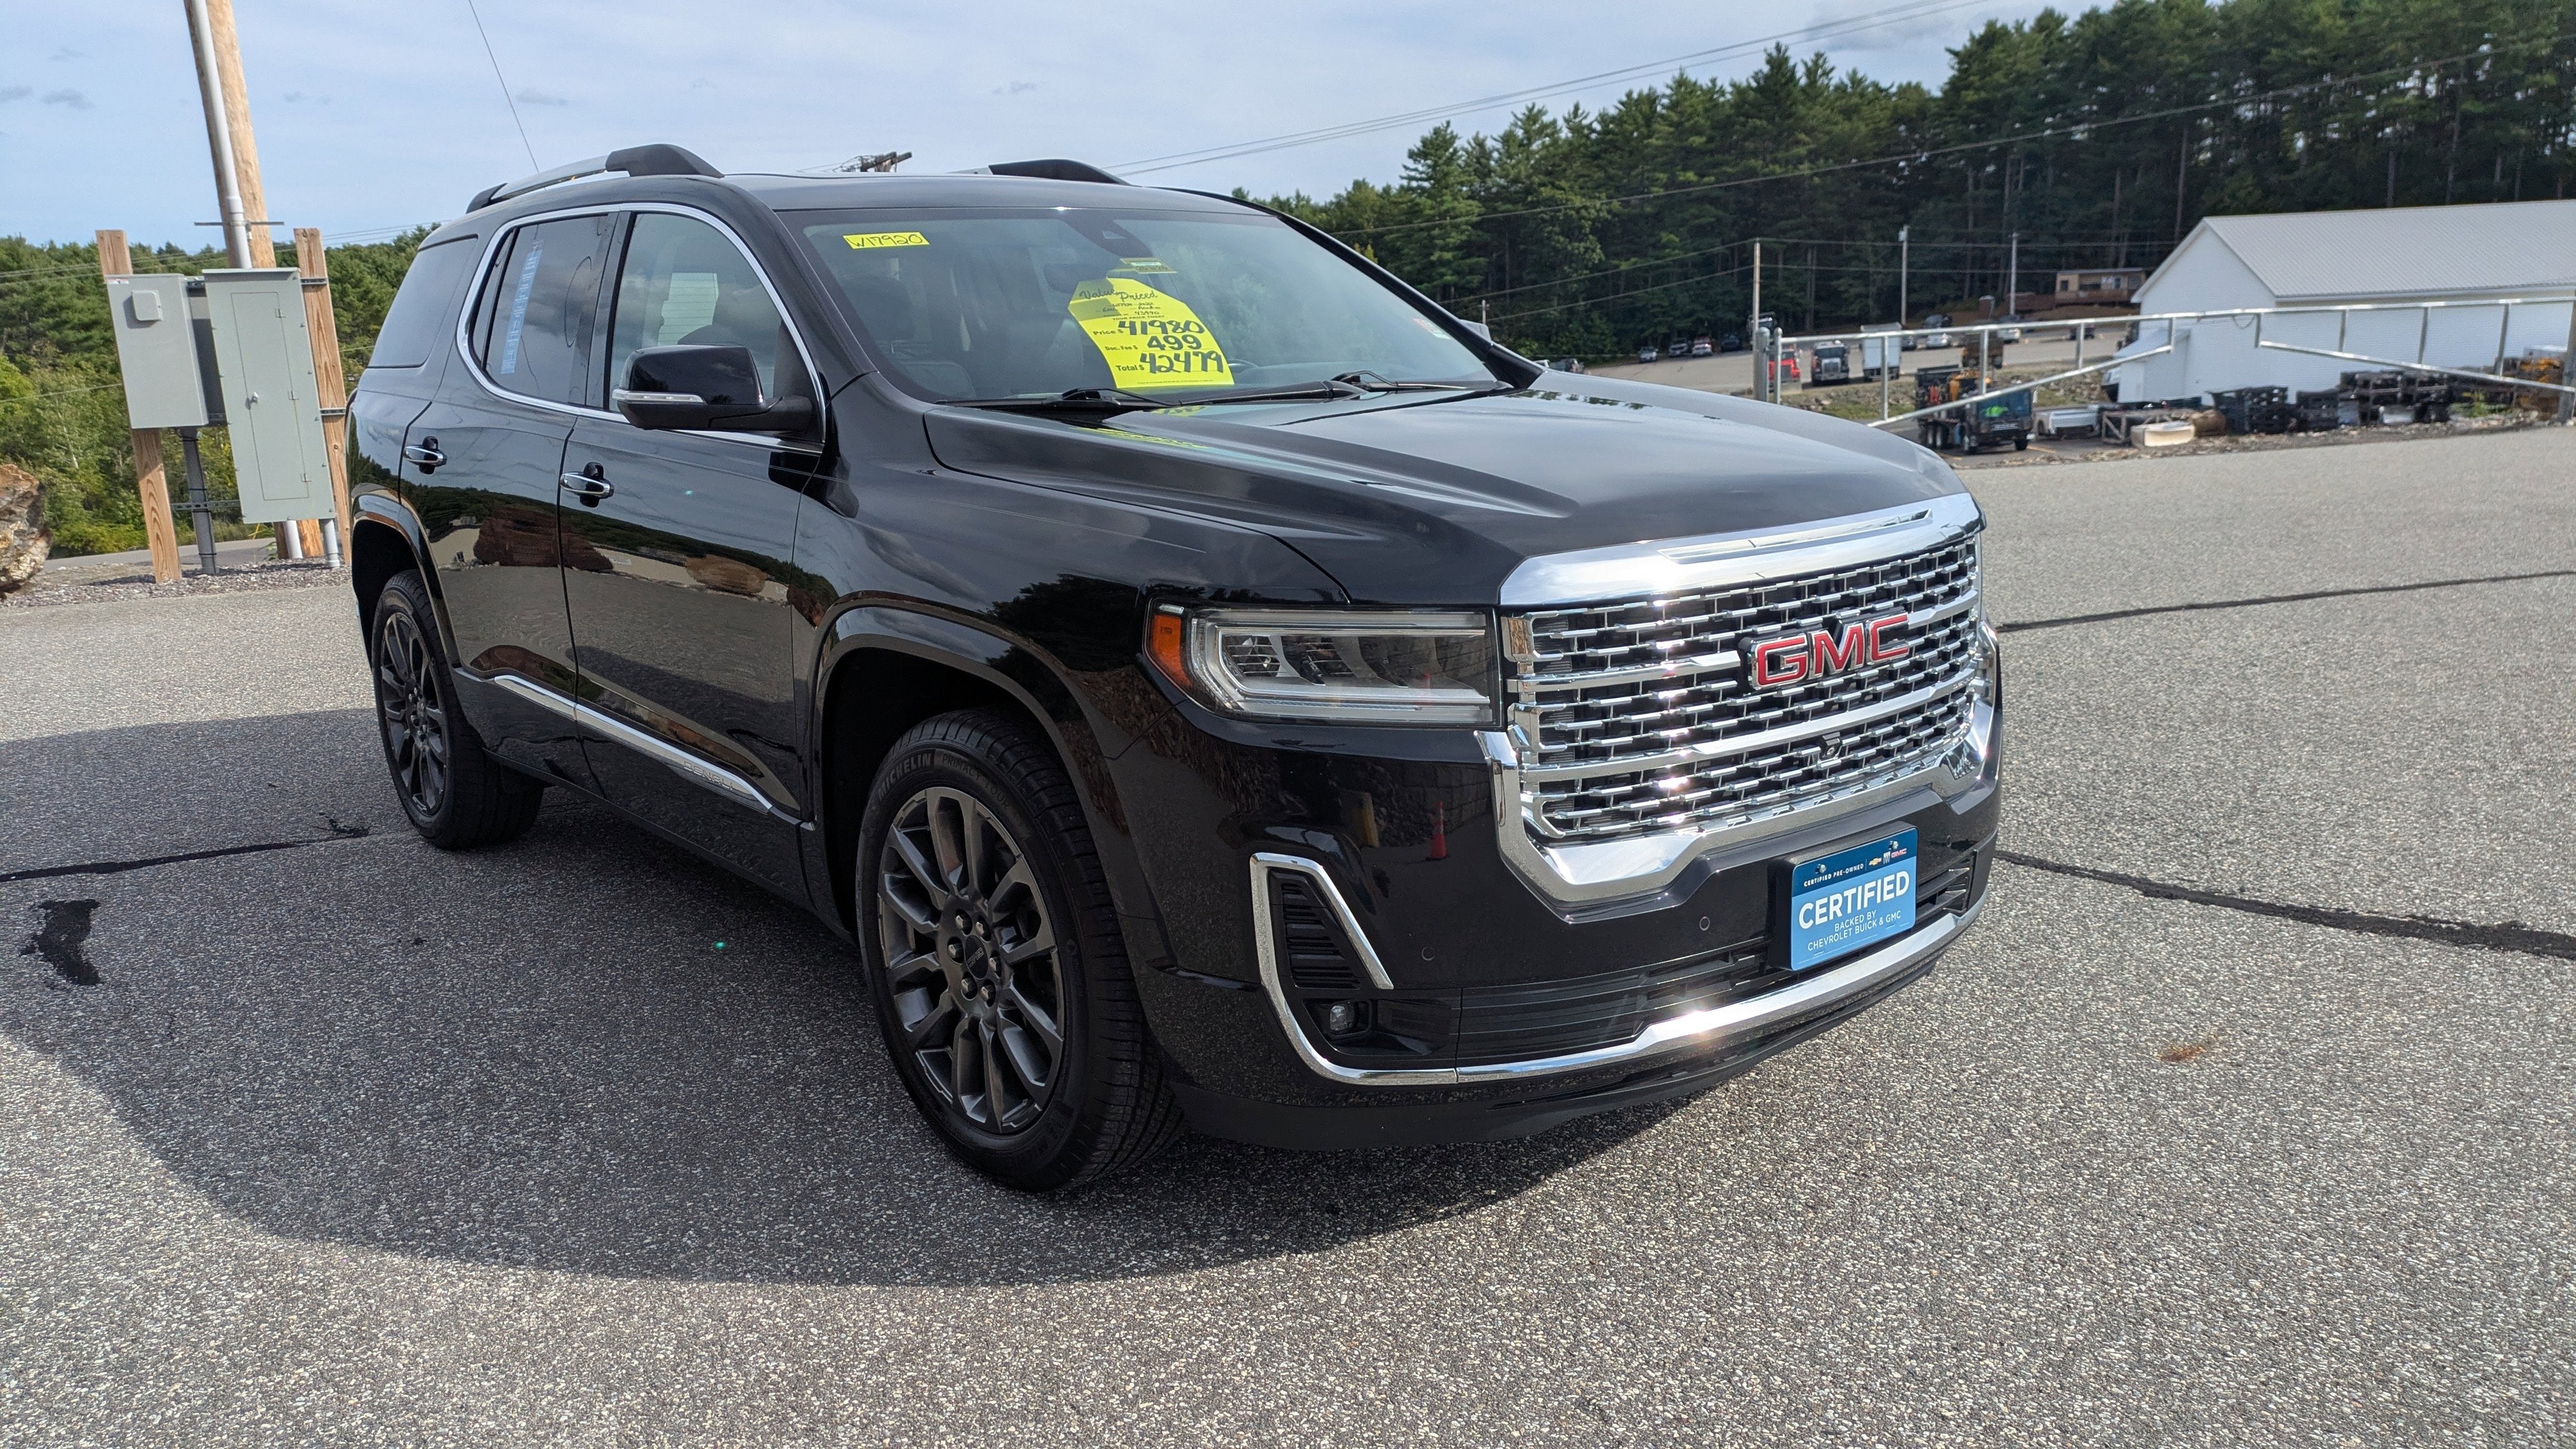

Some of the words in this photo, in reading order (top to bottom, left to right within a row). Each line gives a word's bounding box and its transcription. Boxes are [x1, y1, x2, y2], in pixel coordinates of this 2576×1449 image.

[845, 234, 923, 247] W17920
[1079, 289, 1117, 300] Value
[1119, 290, 1158, 302] Priced
[1118, 319, 1206, 335] 41980
[1147, 334, 1202, 351] 499
[1140, 350, 1224, 374] 42479
[1754, 611, 1910, 688] GMC
[877, 752, 933, 801] MICHELIN
[1804, 870, 1832, 887] CERTIFIED
[1833, 862, 1864, 879] PRE-OWNED
[1890, 848, 1907, 859] GMC
[1798, 870, 1910, 930] CERTIFIED
[1807, 927, 1853, 952] CHEVROLET
[1855, 918, 1878, 935] BUICK
[1885, 910, 1901, 923] GMC
[1834, 914, 1865, 932] BACKED
[1867, 909, 1877, 921] BY
